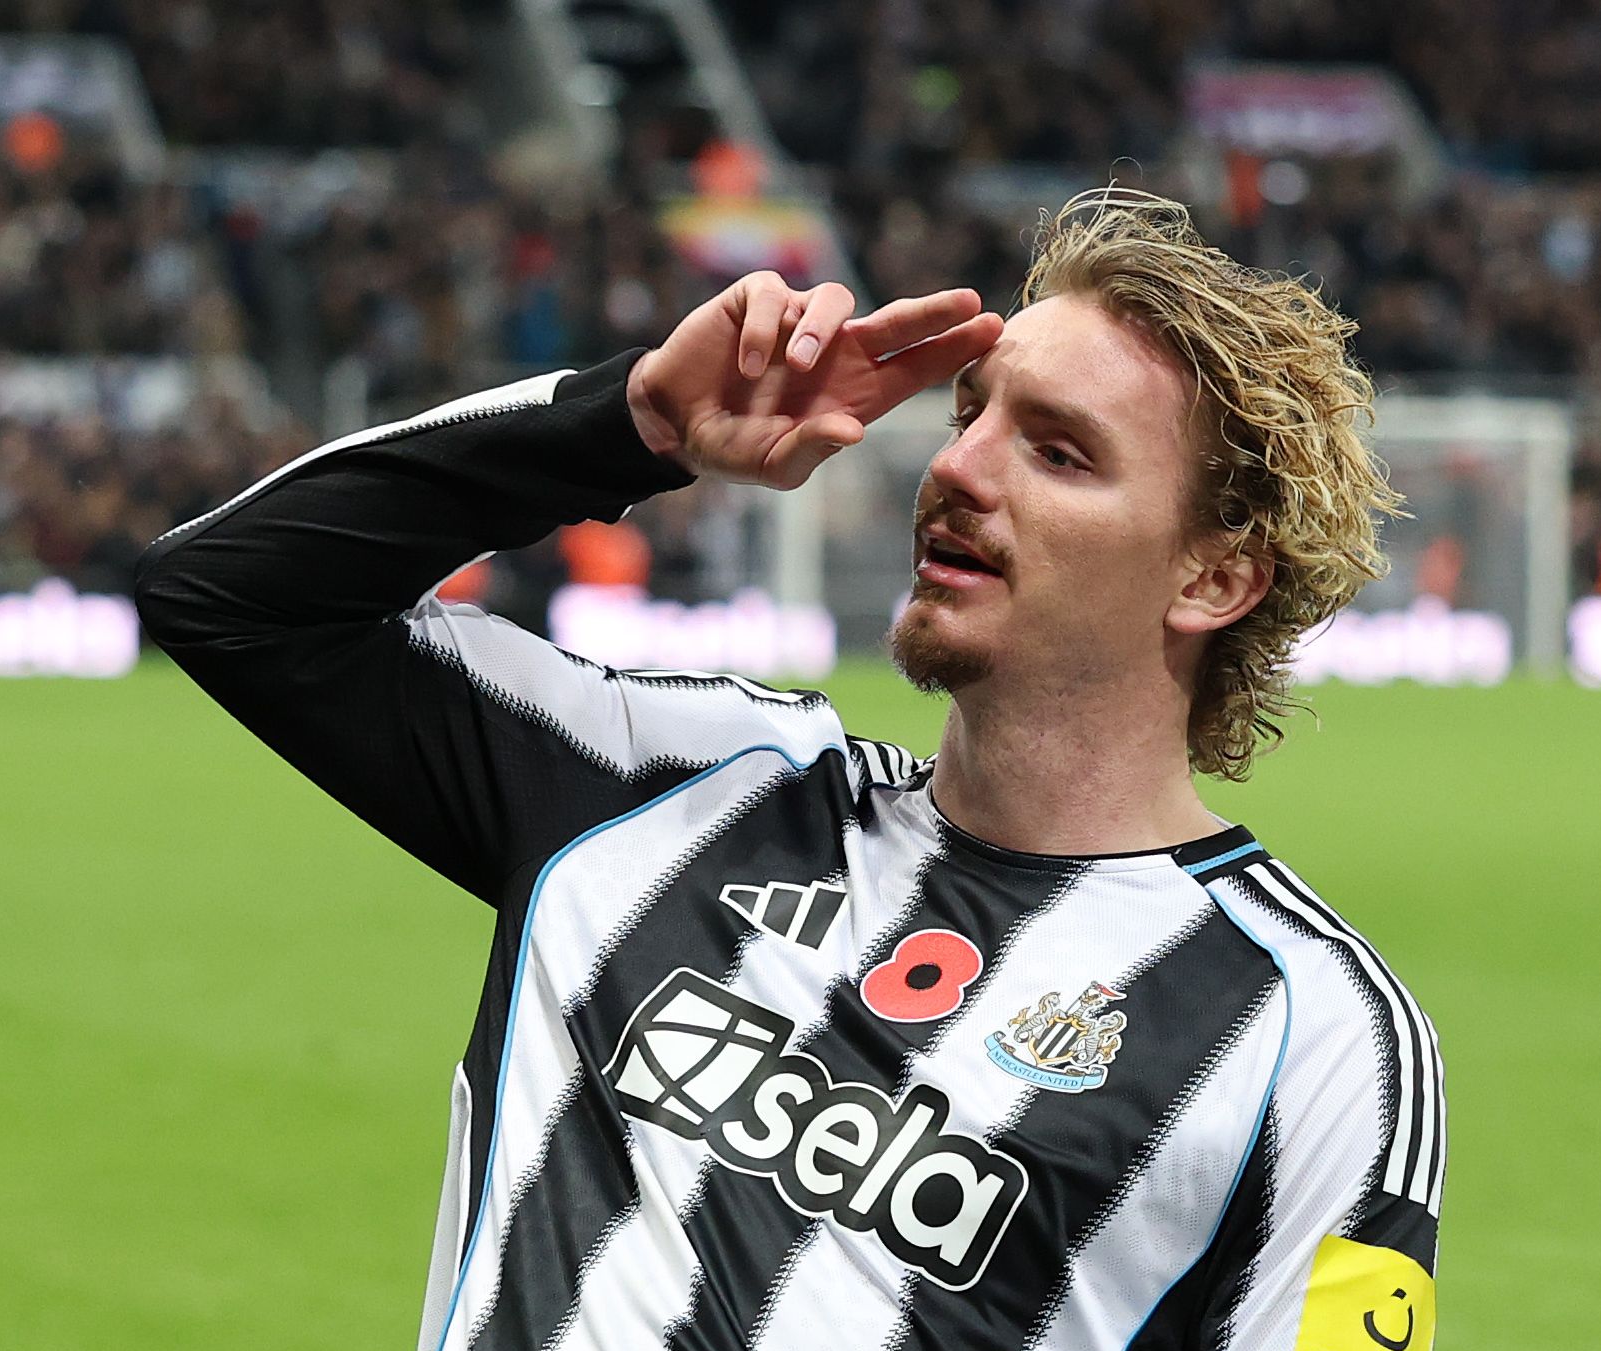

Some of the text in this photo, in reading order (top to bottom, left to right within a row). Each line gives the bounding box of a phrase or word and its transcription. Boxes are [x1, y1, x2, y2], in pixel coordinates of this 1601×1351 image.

[993, 1050, 1078, 1087] NEWCASTLE UNITED
[722, 1073, 1005, 1267] sela
